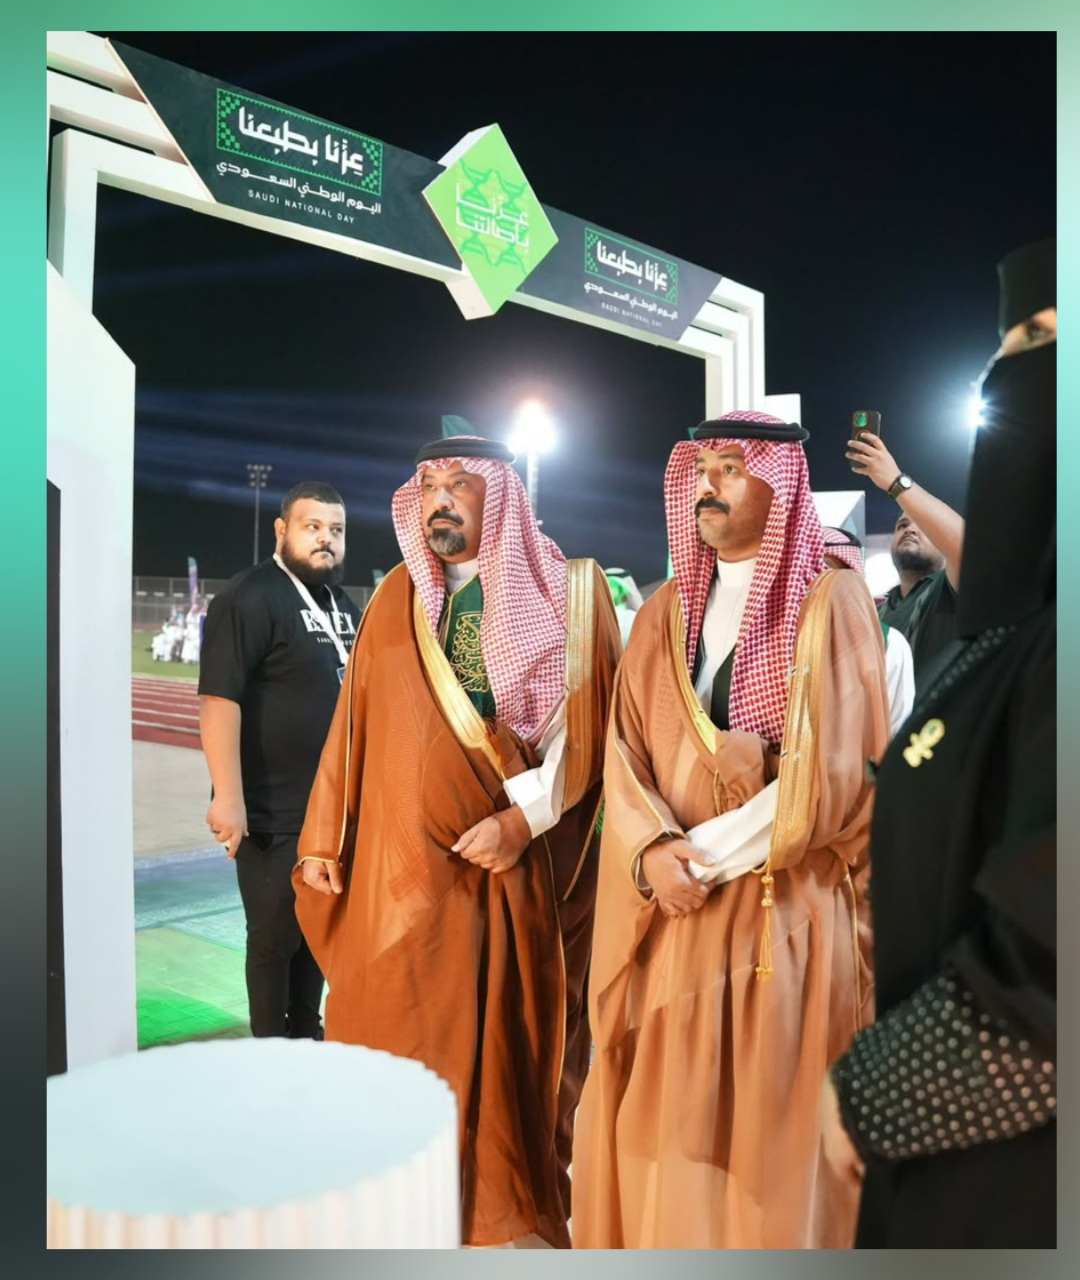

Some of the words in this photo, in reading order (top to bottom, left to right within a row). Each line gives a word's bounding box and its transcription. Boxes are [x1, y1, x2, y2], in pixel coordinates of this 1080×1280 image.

[239, 106, 318, 166] بطبعنا
[216, 160, 297, 189] السعودي
[248, 189, 280, 205] SAUDI
[284, 199, 333, 219] NATIONAL
[336, 212, 355, 224] DAY
[297, 181, 345, 202] الوطني
[346, 197, 382, 216] اليوم
[597, 240, 643, 285] بطبعنا
